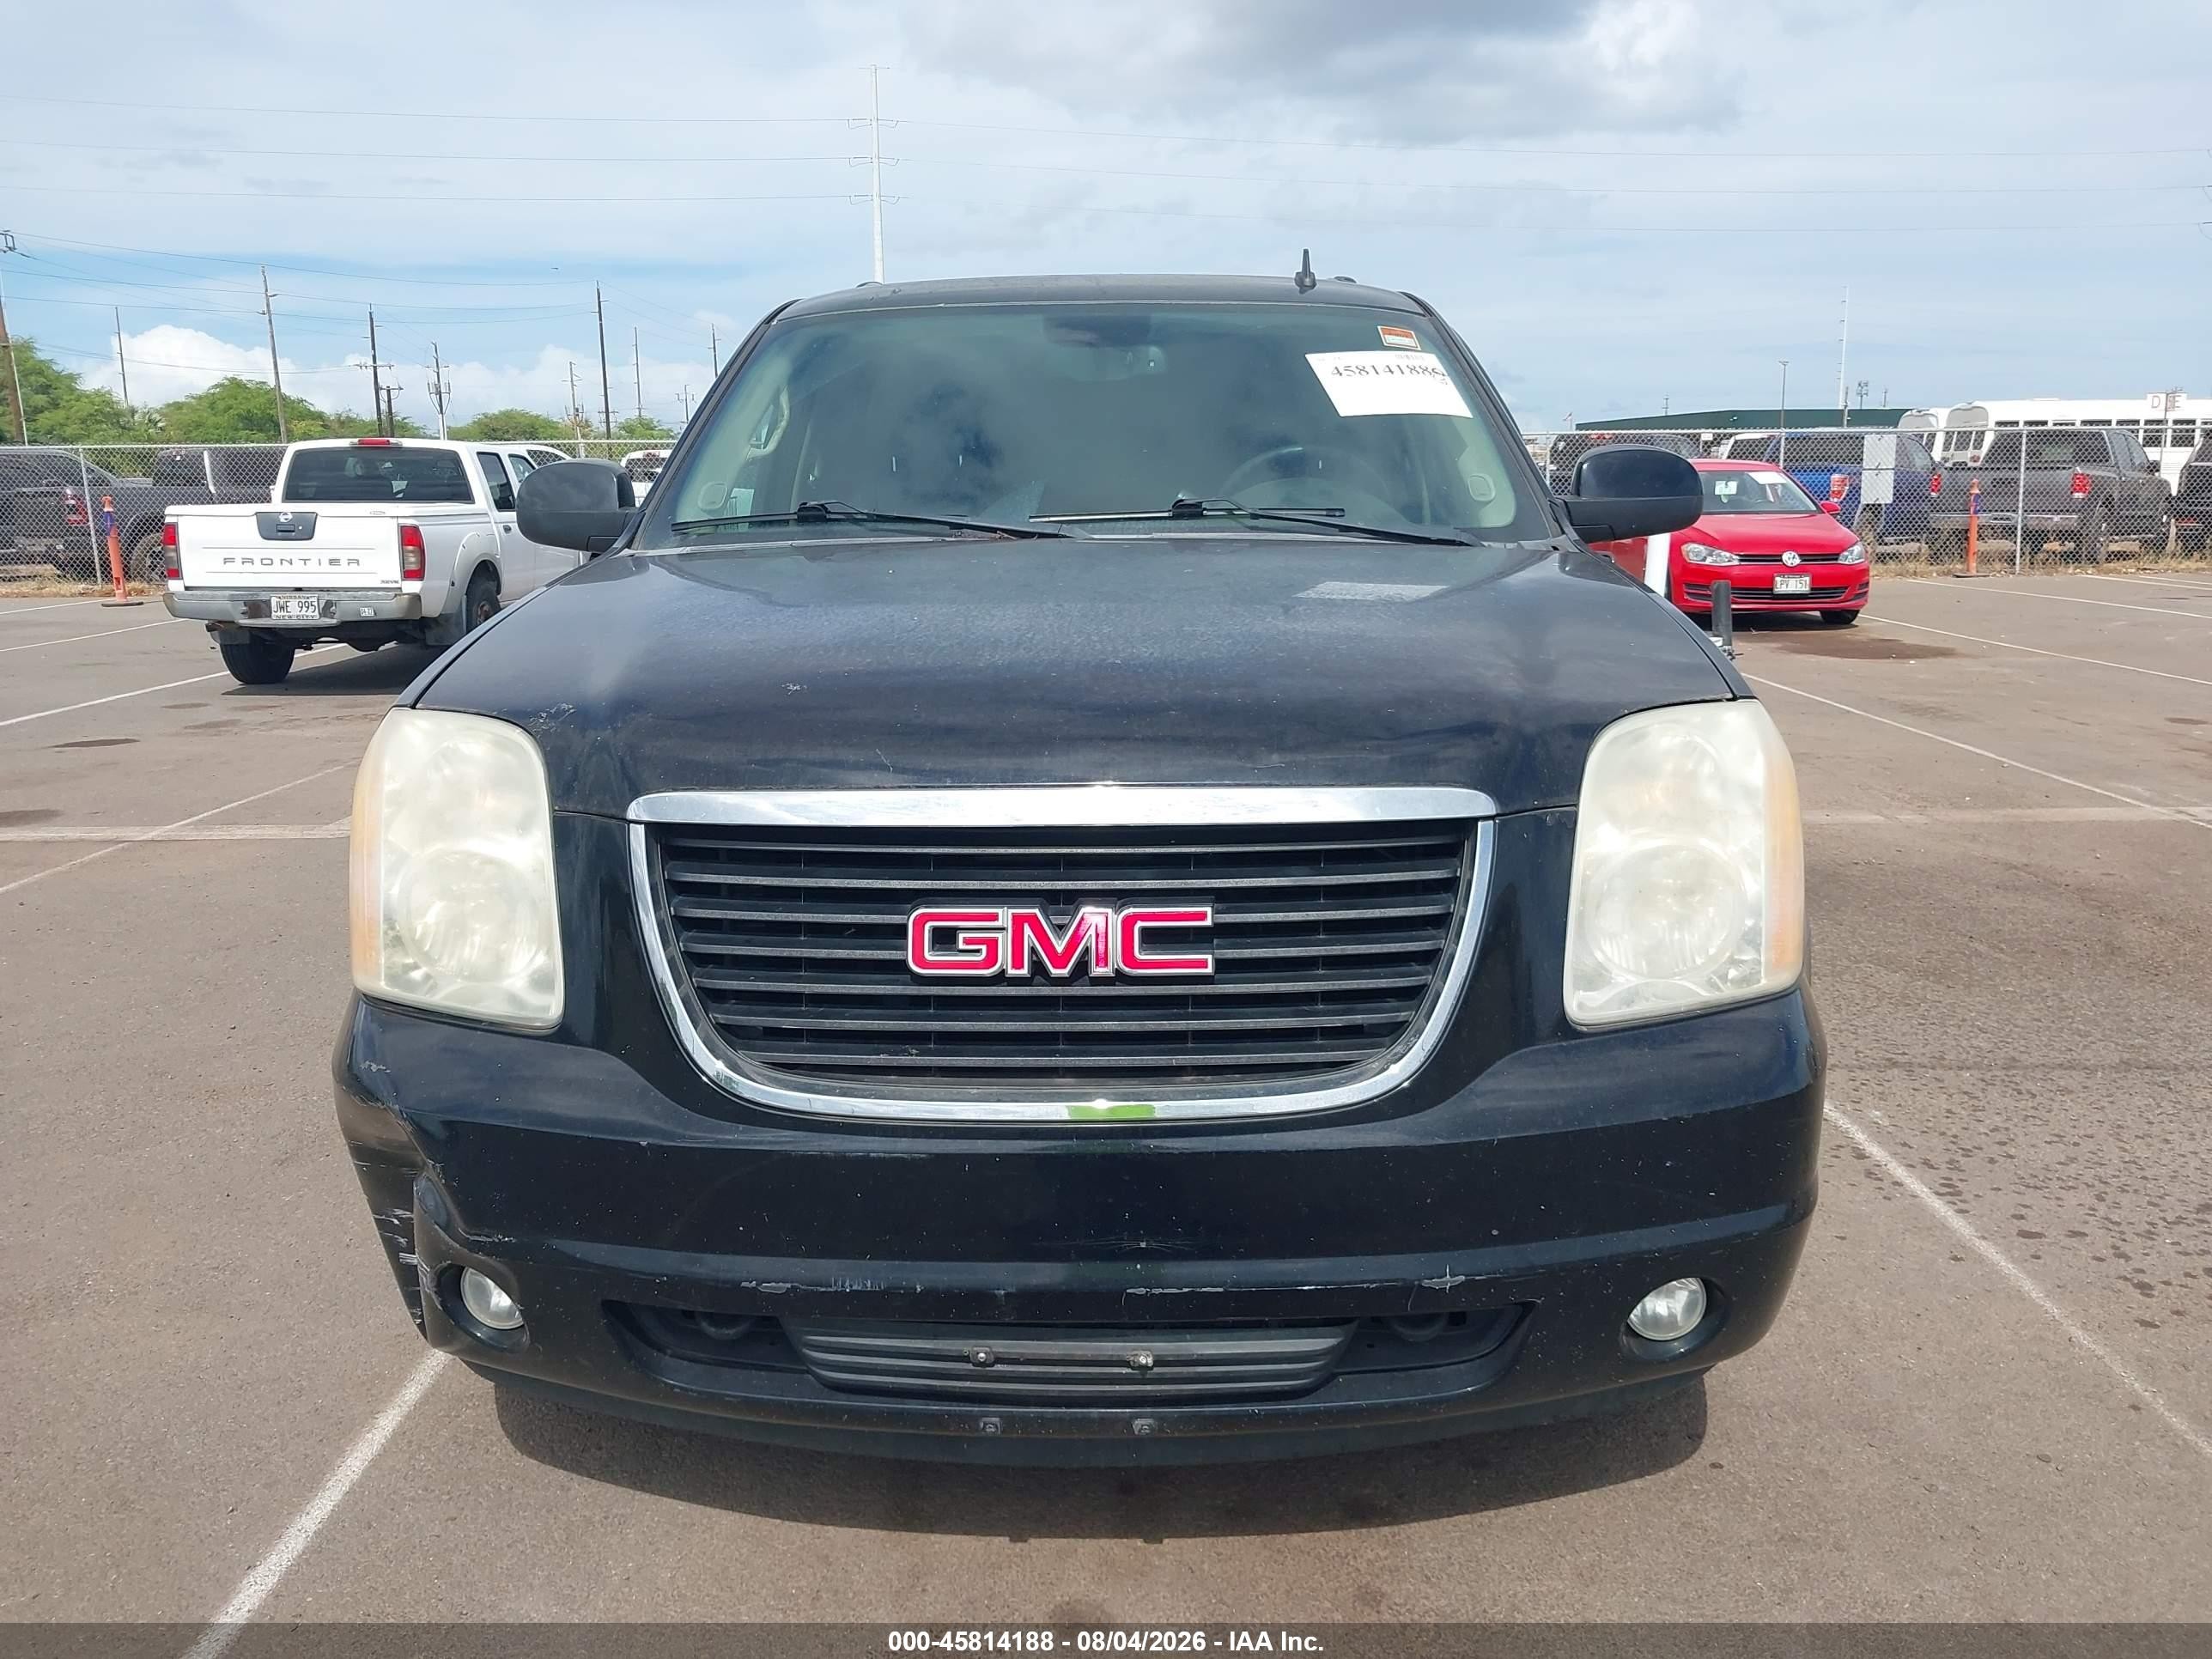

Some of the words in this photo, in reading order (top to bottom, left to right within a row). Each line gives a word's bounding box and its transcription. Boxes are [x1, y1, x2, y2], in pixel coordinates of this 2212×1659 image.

[222, 557, 361, 567] FRONTIER
[273, 600, 292, 614] JWE
[297, 600, 317, 613] 995
[907, 907, 1213, 976] GMC
